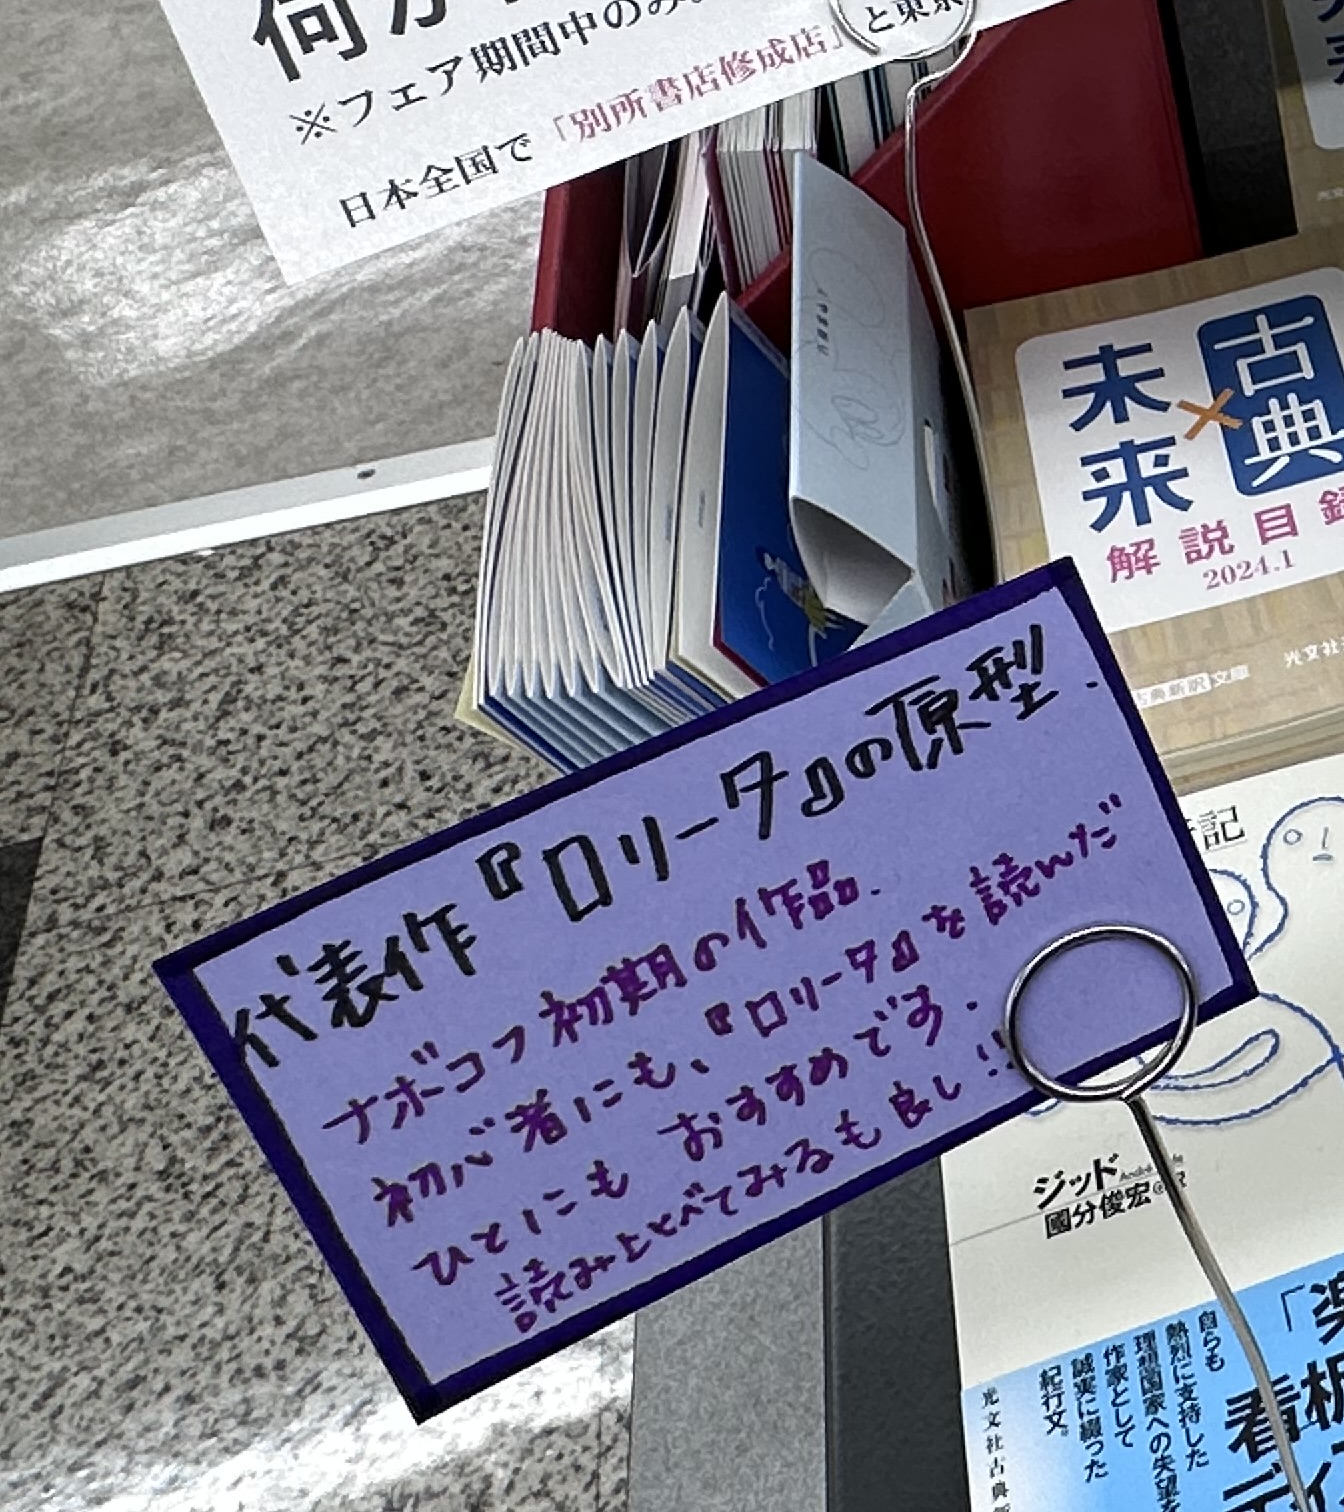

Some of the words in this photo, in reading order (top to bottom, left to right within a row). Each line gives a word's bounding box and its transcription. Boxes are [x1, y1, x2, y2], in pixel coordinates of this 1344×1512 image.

[1061, 342, 1195, 534] 未来
[1203, 548, 1296, 589] 2024.1
[1032, 1153, 1120, 1211] ジッド
[1103, 1343, 1136, 1450] 作家として
